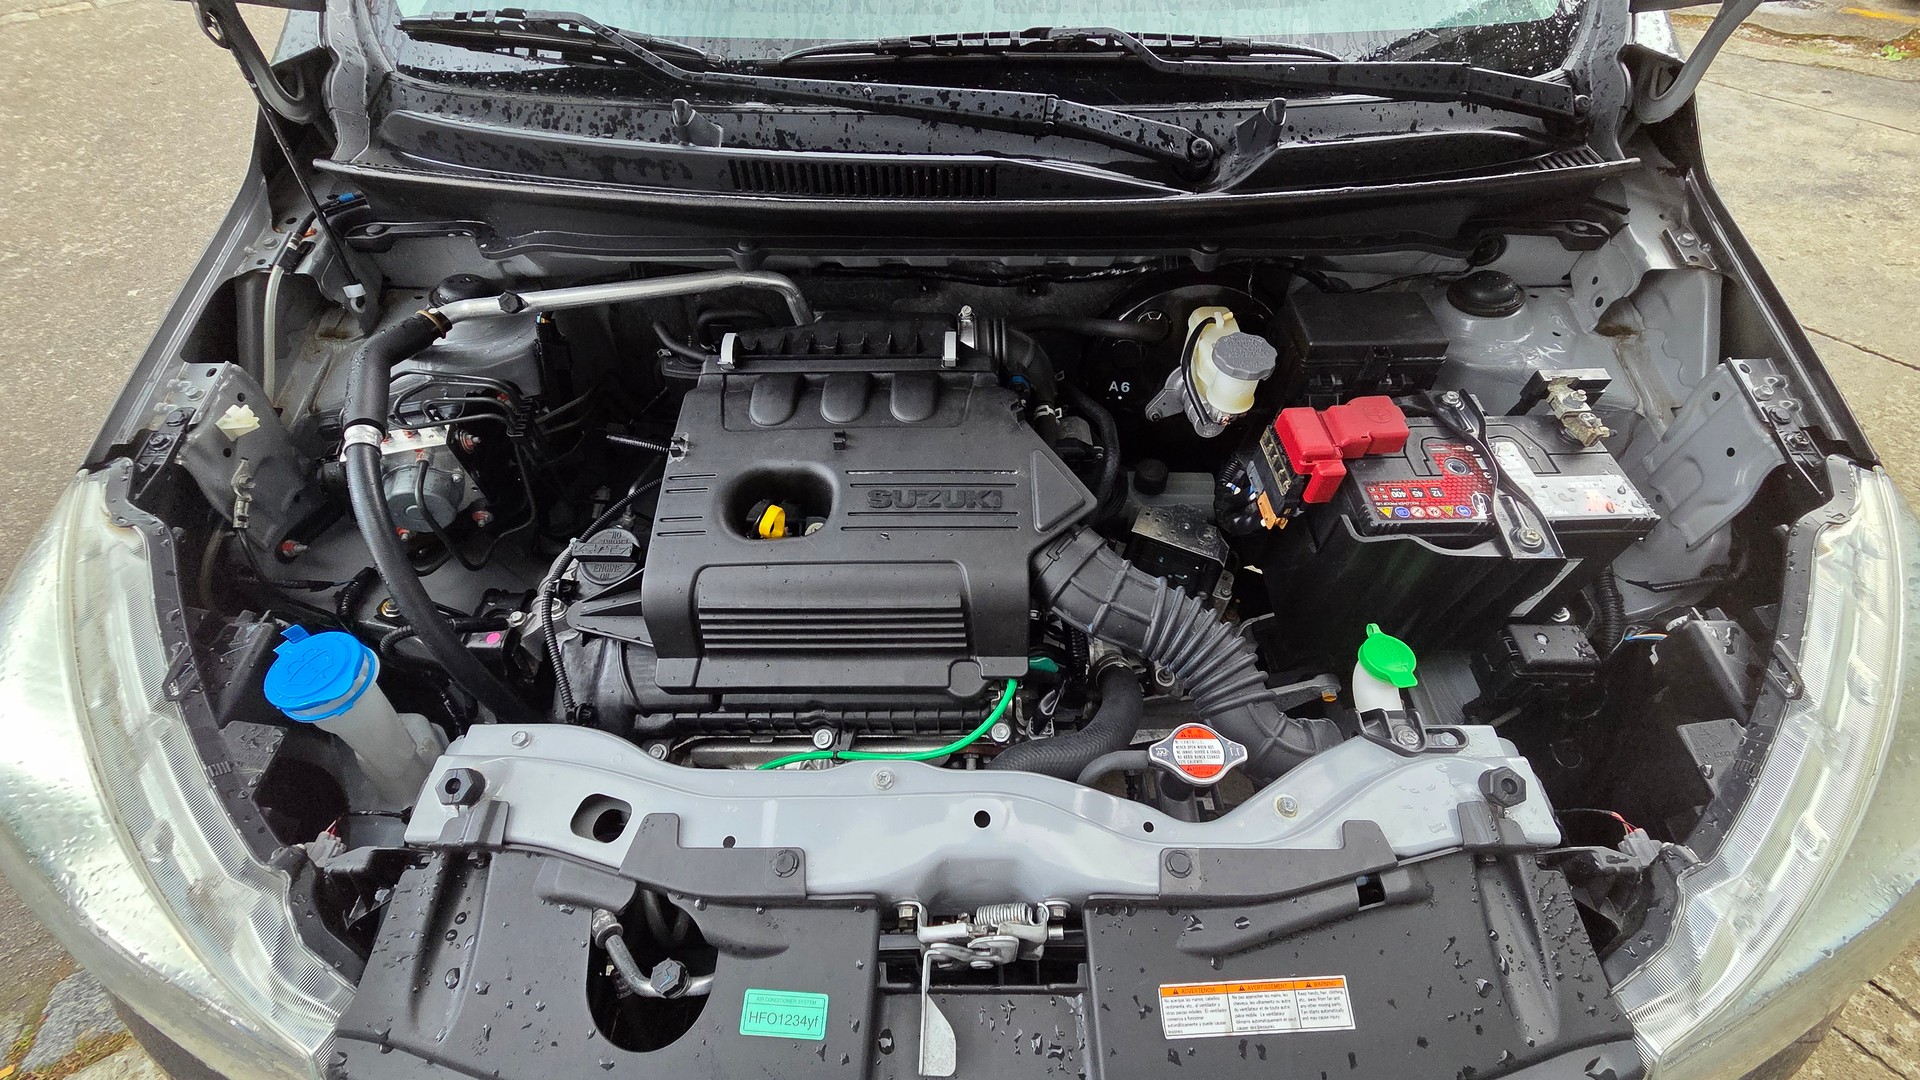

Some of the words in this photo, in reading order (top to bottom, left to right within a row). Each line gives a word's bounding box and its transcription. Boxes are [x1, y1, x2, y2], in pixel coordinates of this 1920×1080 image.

[1108, 380, 1131, 393] A6
[867, 489, 1002, 509] SUZUKI
[593, 564, 623, 573] ENGINE
[748, 1011, 819, 1031] HFO1234yf
